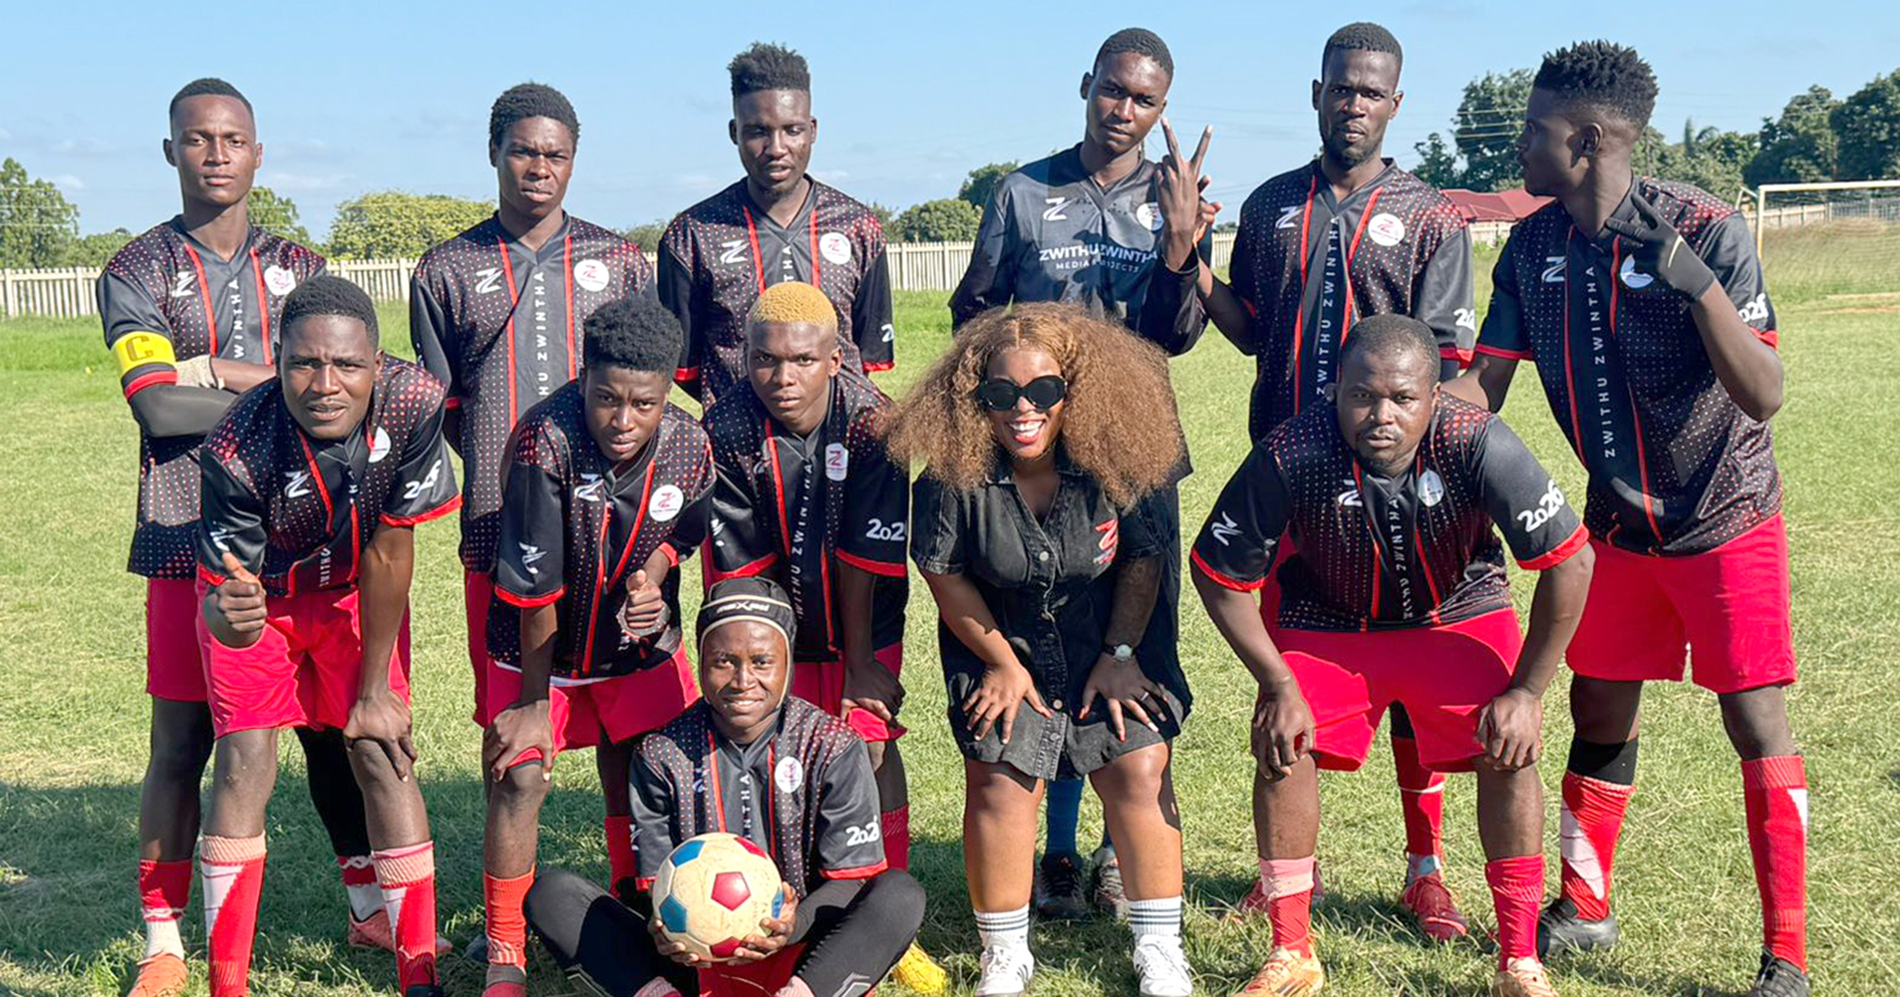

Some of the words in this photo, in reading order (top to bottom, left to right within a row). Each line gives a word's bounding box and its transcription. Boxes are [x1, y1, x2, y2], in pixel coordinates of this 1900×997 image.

[1056, 260, 1090, 270] MEDIA
[1323, 215, 1340, 307] ZWINTHA
[126, 335, 154, 362] C
[533, 271, 548, 361] ZWINTHA
[1586, 266, 1606, 365] ZWINTHA
[1316, 319, 1331, 395] ZWITHU
[1597, 377, 1616, 458] ZWITHU
[866, 518, 907, 541] 202
[1517, 479, 1565, 532] 2026
